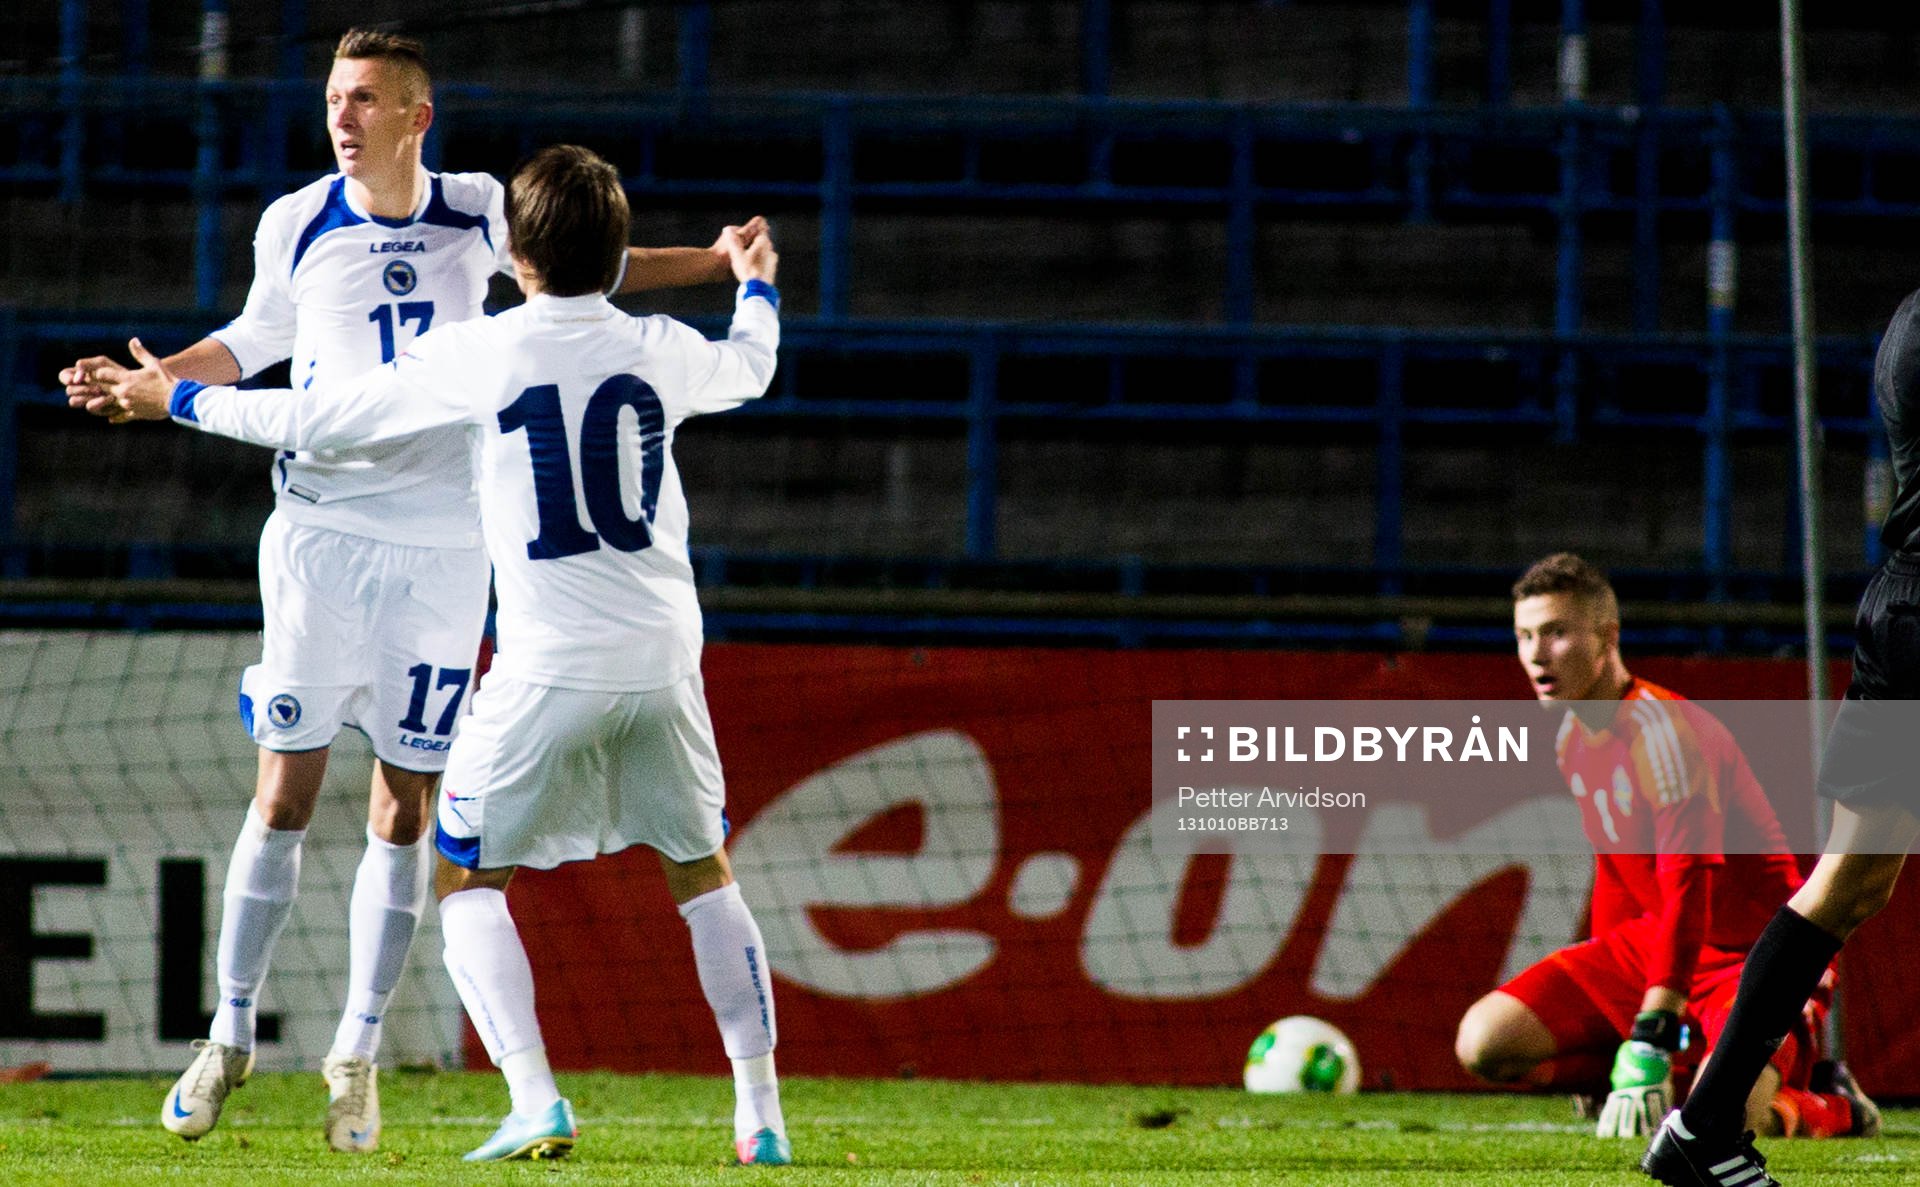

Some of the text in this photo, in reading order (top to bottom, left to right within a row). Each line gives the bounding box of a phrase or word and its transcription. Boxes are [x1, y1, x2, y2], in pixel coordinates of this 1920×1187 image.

[369, 240, 426, 254] LEGEA
[368, 300, 436, 365] 17
[497, 373, 666, 561] 10
[398, 662, 472, 736] 17
